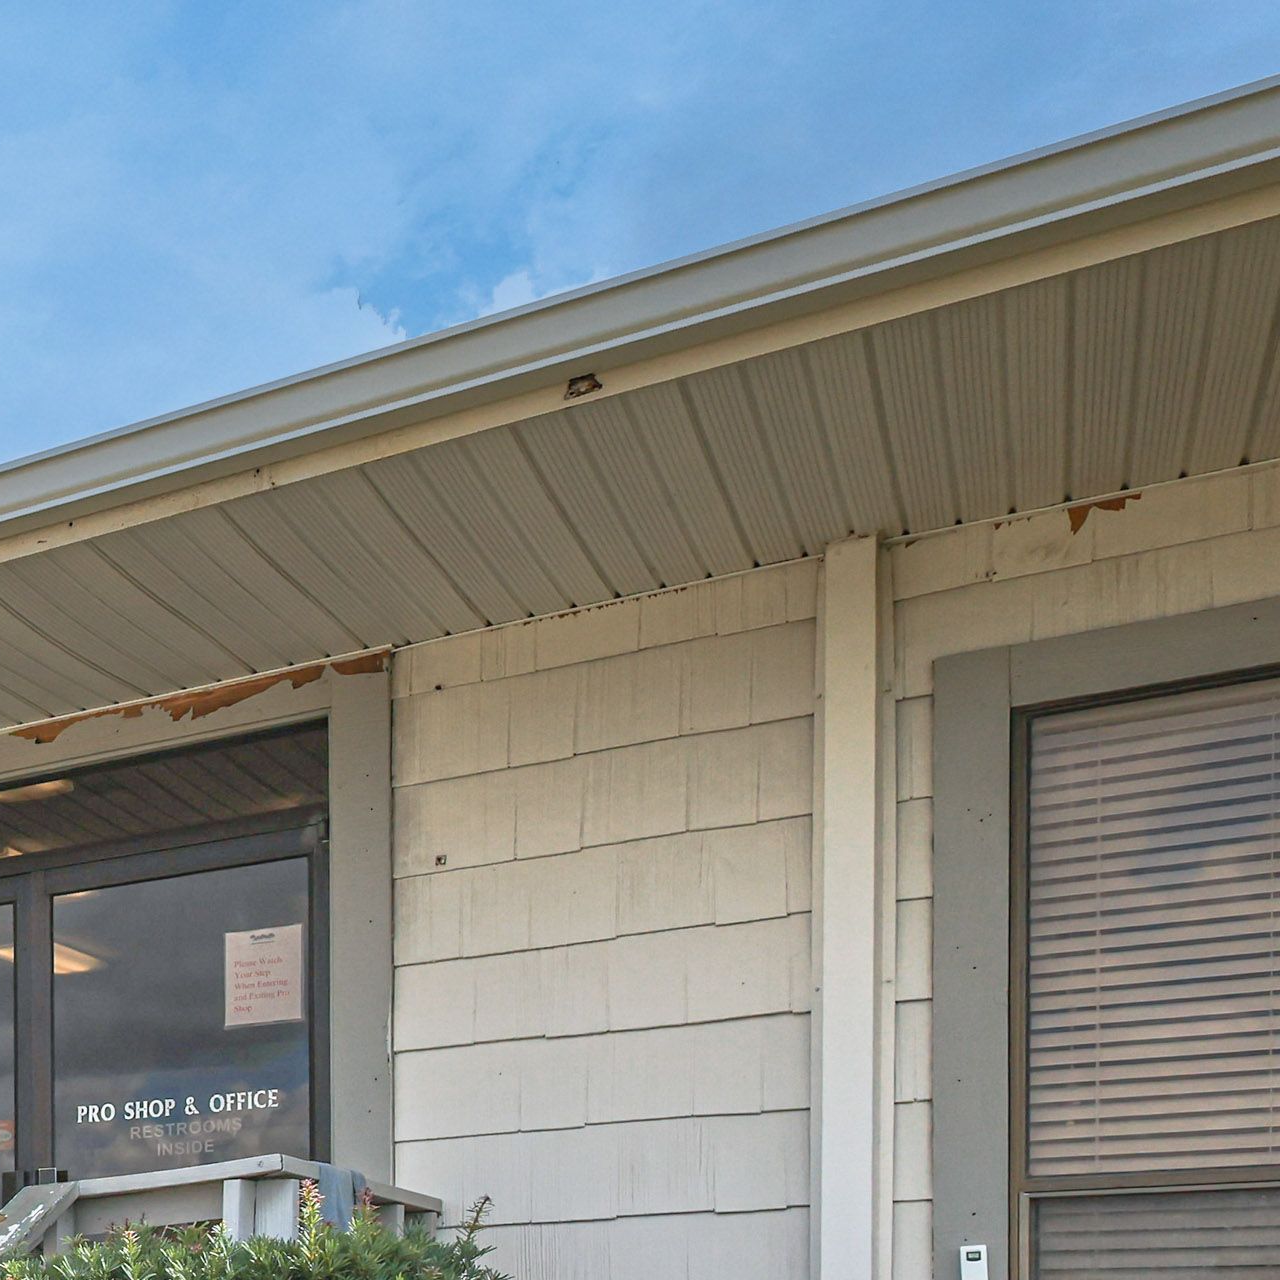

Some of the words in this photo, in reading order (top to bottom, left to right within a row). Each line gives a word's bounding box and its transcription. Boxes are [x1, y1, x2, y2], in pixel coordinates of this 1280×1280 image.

[234, 971, 253, 979] Your
[76, 1103, 116, 1124] PRO
[124, 1098, 176, 1121] SHOP
[184, 1096, 200, 1116] &
[209, 1088, 279, 1113] OFFICE
[130, 1117, 242, 1140] RESTROOMS
[157, 1138, 215, 1157] INSIDE
